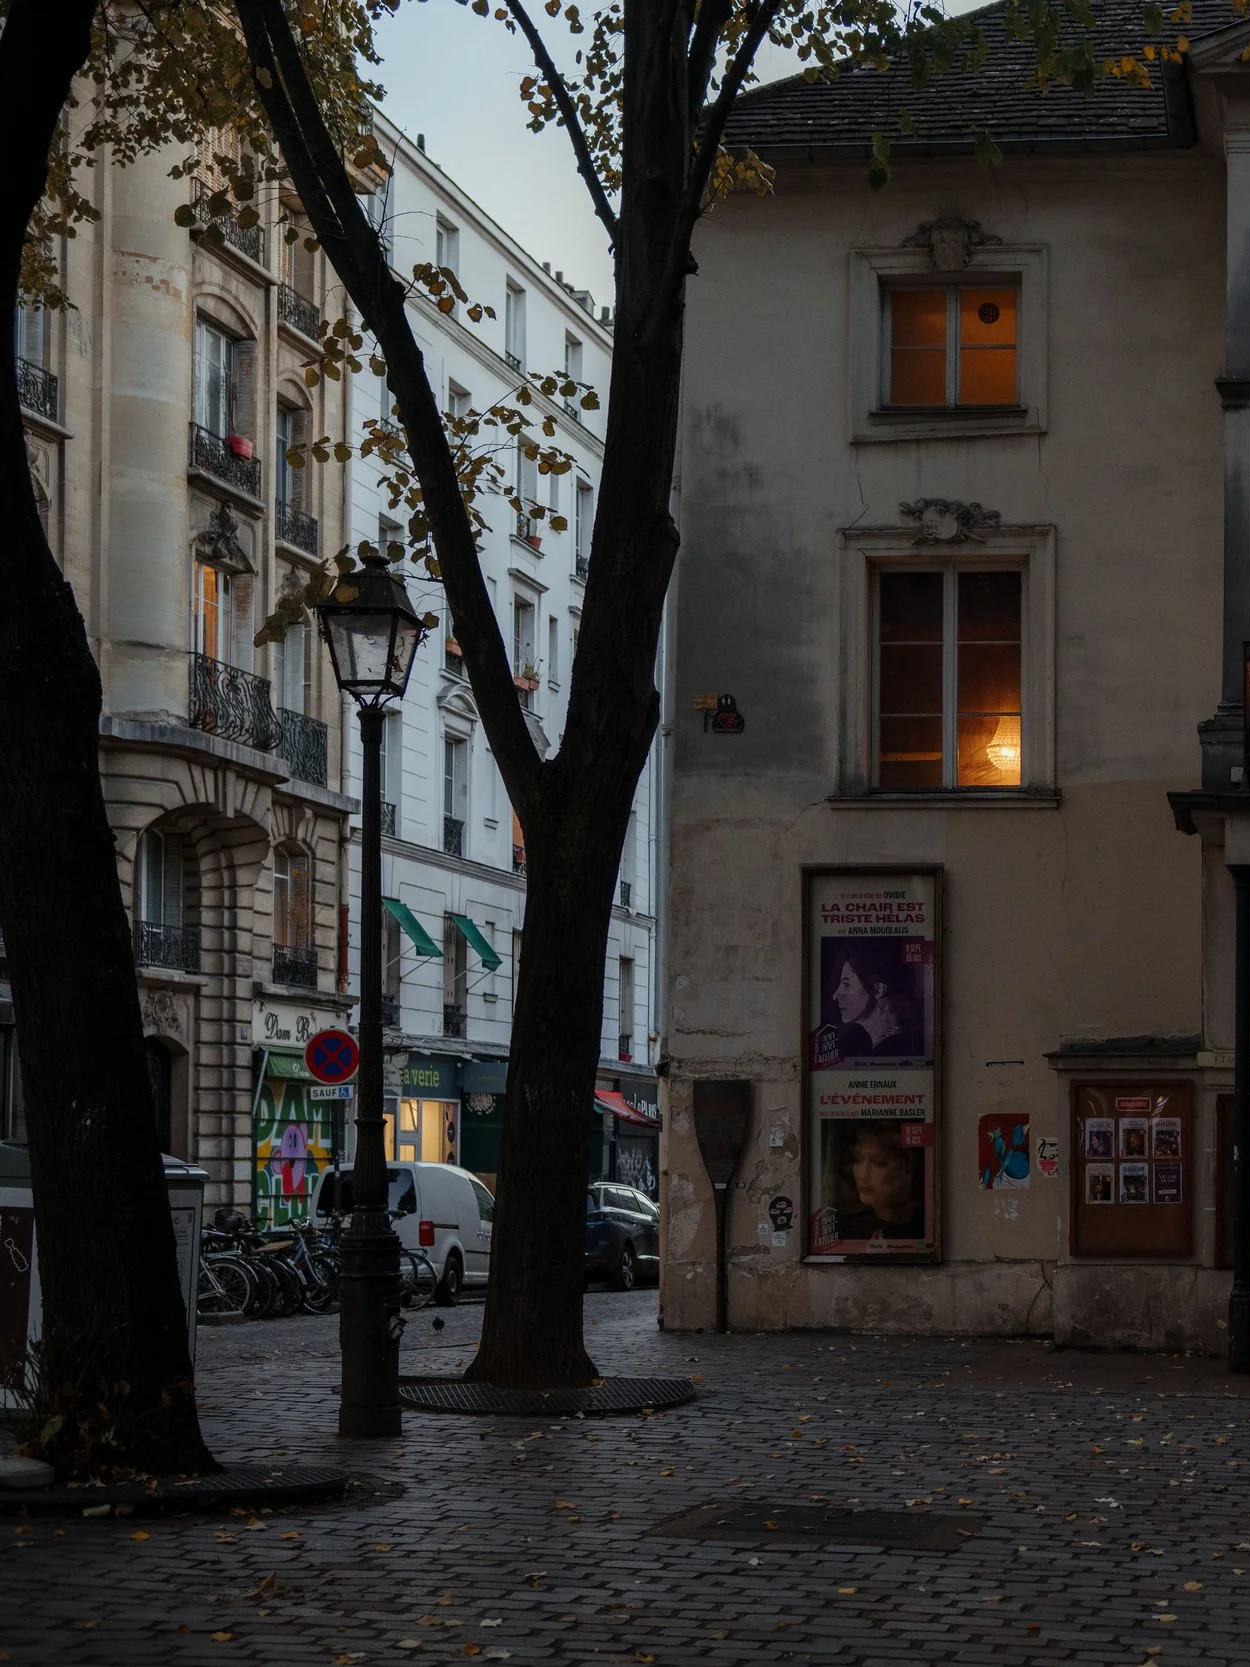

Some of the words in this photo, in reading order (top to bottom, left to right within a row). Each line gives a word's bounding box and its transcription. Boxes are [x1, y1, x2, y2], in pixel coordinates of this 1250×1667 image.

[883, 891, 906, 899] OVIDIE
[821, 903, 841, 912] LA
[844, 902, 893, 912] CHAIR
[897, 902, 925, 911] EST
[821, 914, 872, 924] TRISTE
[875, 911, 925, 923] HÉLAS
[848, 926, 868, 934] ANNA
[869, 926, 909, 934] MOUGLALIS
[264, 1012, 291, 1041] Dam
[848, 1081, 869, 1089] ANNIE
[870, 1081, 897, 1089] ERNAUX
[312, 1088, 337, 1098] SAUF
[820, 1092, 925, 1105] L'ÉVÉNEMENT
[860, 1108, 898, 1117] MARIANNE
[899, 1108, 925, 1117] BASLER
